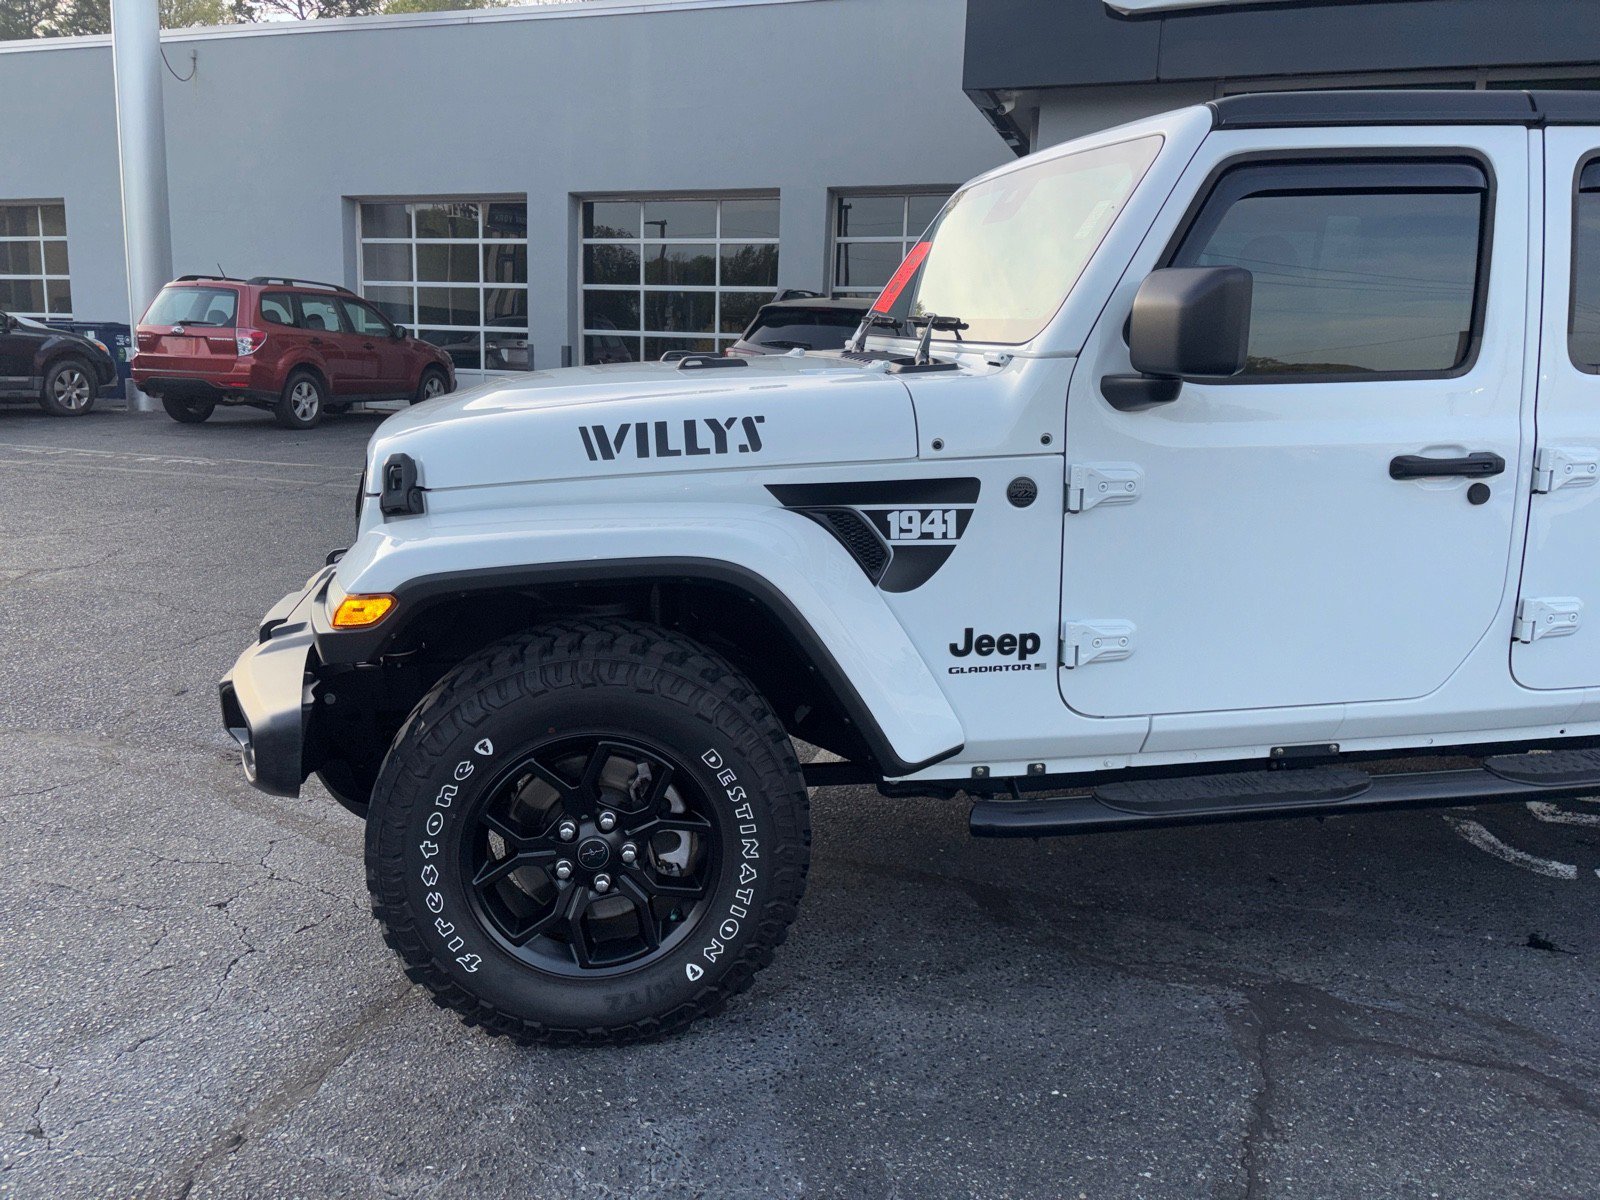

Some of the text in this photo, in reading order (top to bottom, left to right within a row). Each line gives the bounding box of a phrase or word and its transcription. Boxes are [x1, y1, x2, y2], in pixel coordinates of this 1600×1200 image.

[578, 415, 765, 461] WILLYS
[886, 510, 957, 540] 1941
[949, 628, 1041, 660] Jeep
[948, 663, 1032, 675] GLADIATOR
[419, 760, 482, 974] Firestone
[701, 749, 760, 963] DESTINATION
